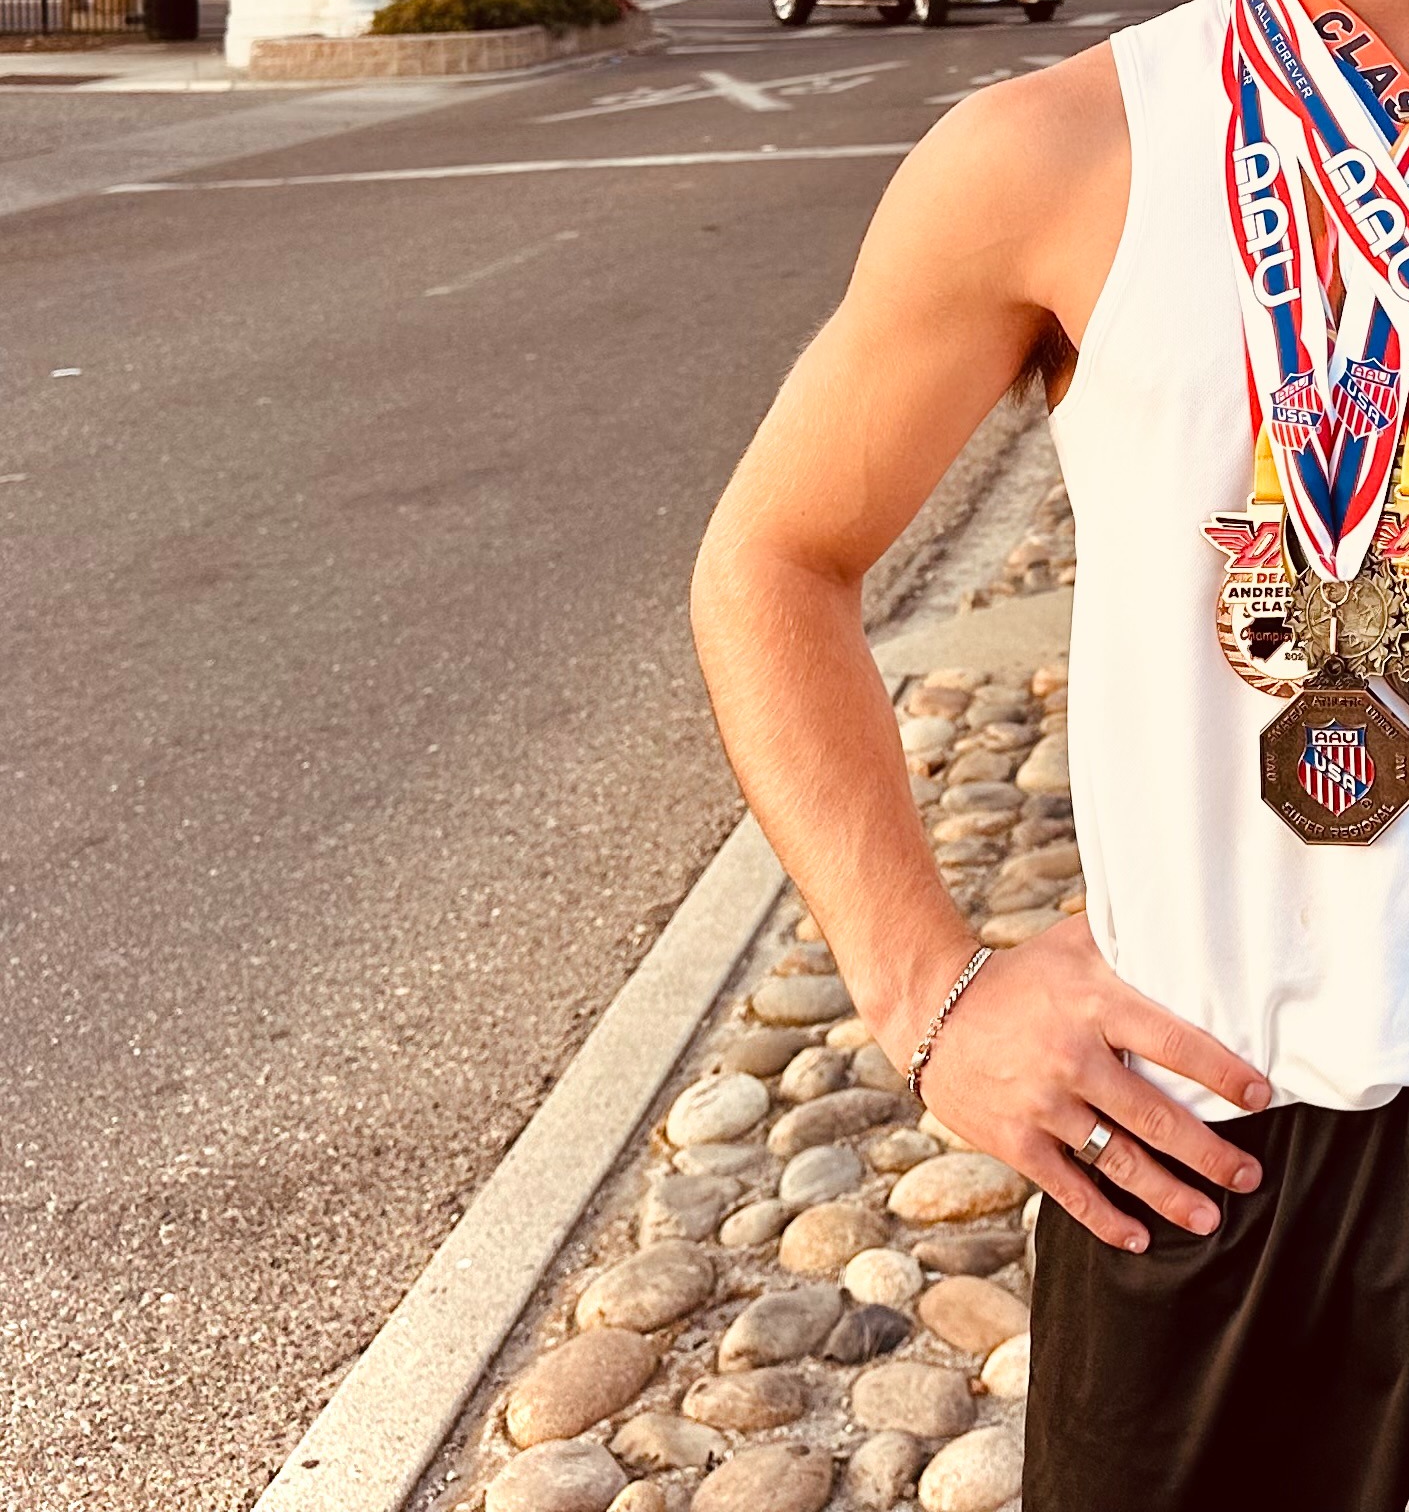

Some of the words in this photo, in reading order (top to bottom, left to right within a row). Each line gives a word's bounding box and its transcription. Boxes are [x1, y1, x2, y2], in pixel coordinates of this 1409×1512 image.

[1271, 33, 1313, 99] FOREVER
[1233, 141, 1301, 307] AAU
[1276, 376, 1308, 403] AAU
[1355, 365, 1390, 385] AAU
[1277, 408, 1313, 426] USA
[1347, 379, 1380, 426] USA
[1314, 731, 1356, 744] AAU
[1314, 750, 1356, 796] USA
[1281, 801, 1325, 836] SUPER
[1330, 803, 1395, 838] REGIONAL
